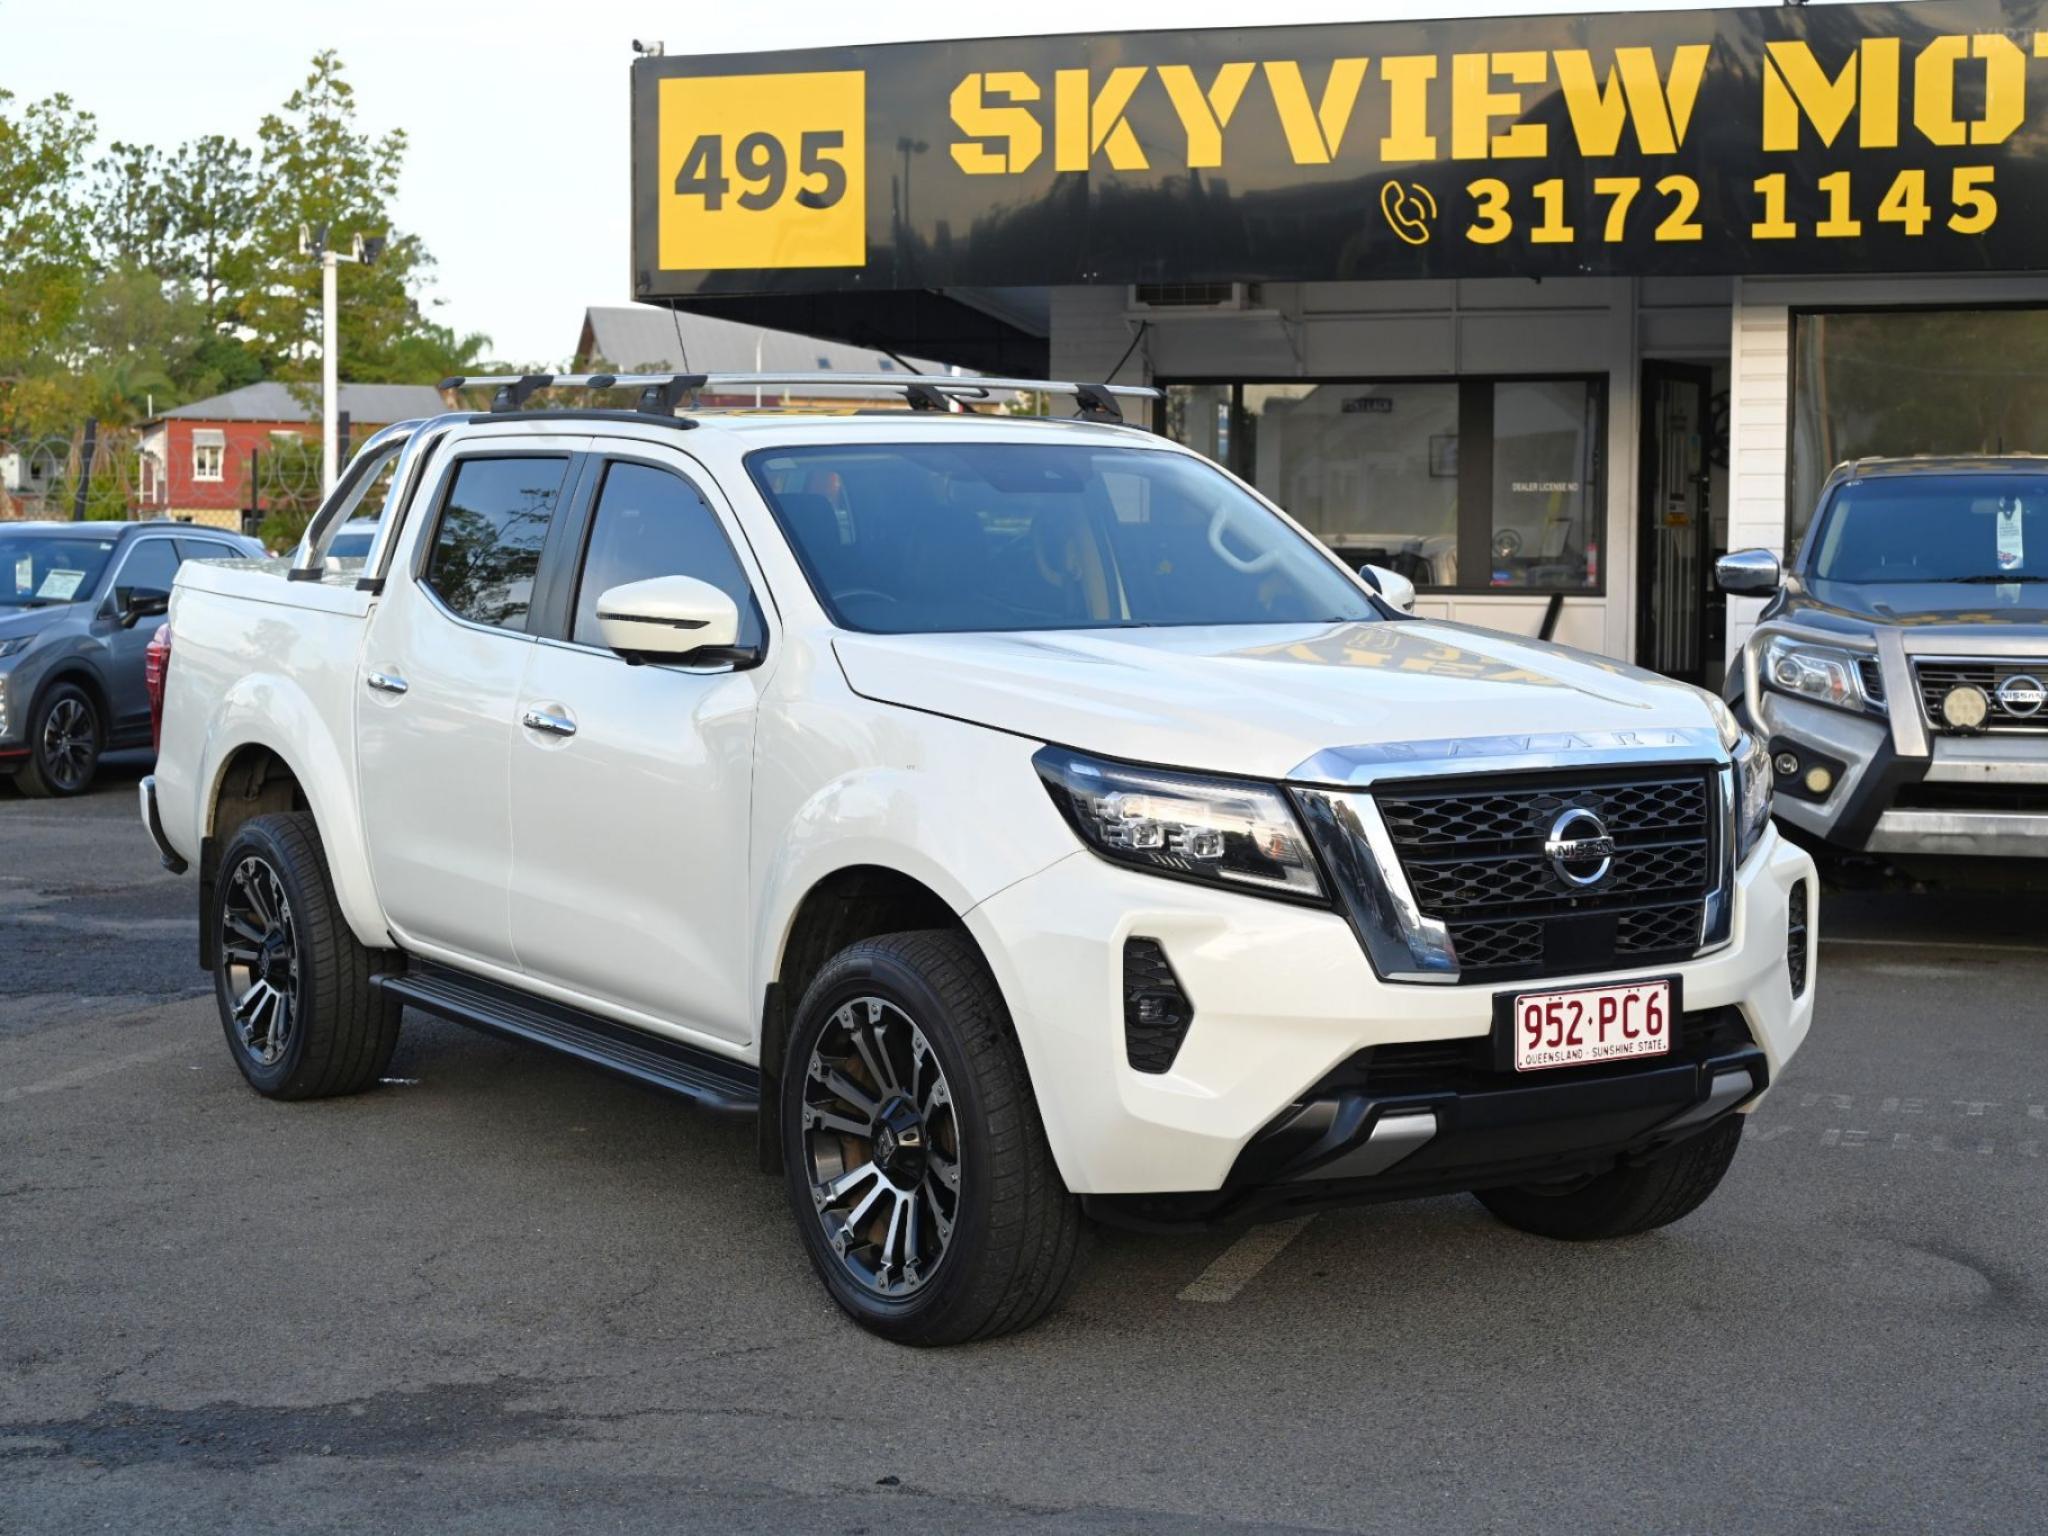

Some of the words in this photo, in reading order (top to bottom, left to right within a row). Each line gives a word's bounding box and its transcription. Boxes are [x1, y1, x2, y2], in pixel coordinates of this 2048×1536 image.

[948, 43, 1712, 176] SKYVIEW
[1762, 31, 2048, 152] MO
[675, 131, 847, 210] 495
[1466, 174, 1703, 244] 3172
[1751, 166, 1998, 239] 1145
[1512, 482, 1537, 492] DEALER
[2001, 691, 2044, 700] NISSAN
[1556, 839, 1613, 857] NISSAN
[1525, 1049, 1583, 1065] QUEENSLAND
[1592, 1043, 1634, 1058] SUNSHINE
[1638, 1039, 1662, 1051] STATE
